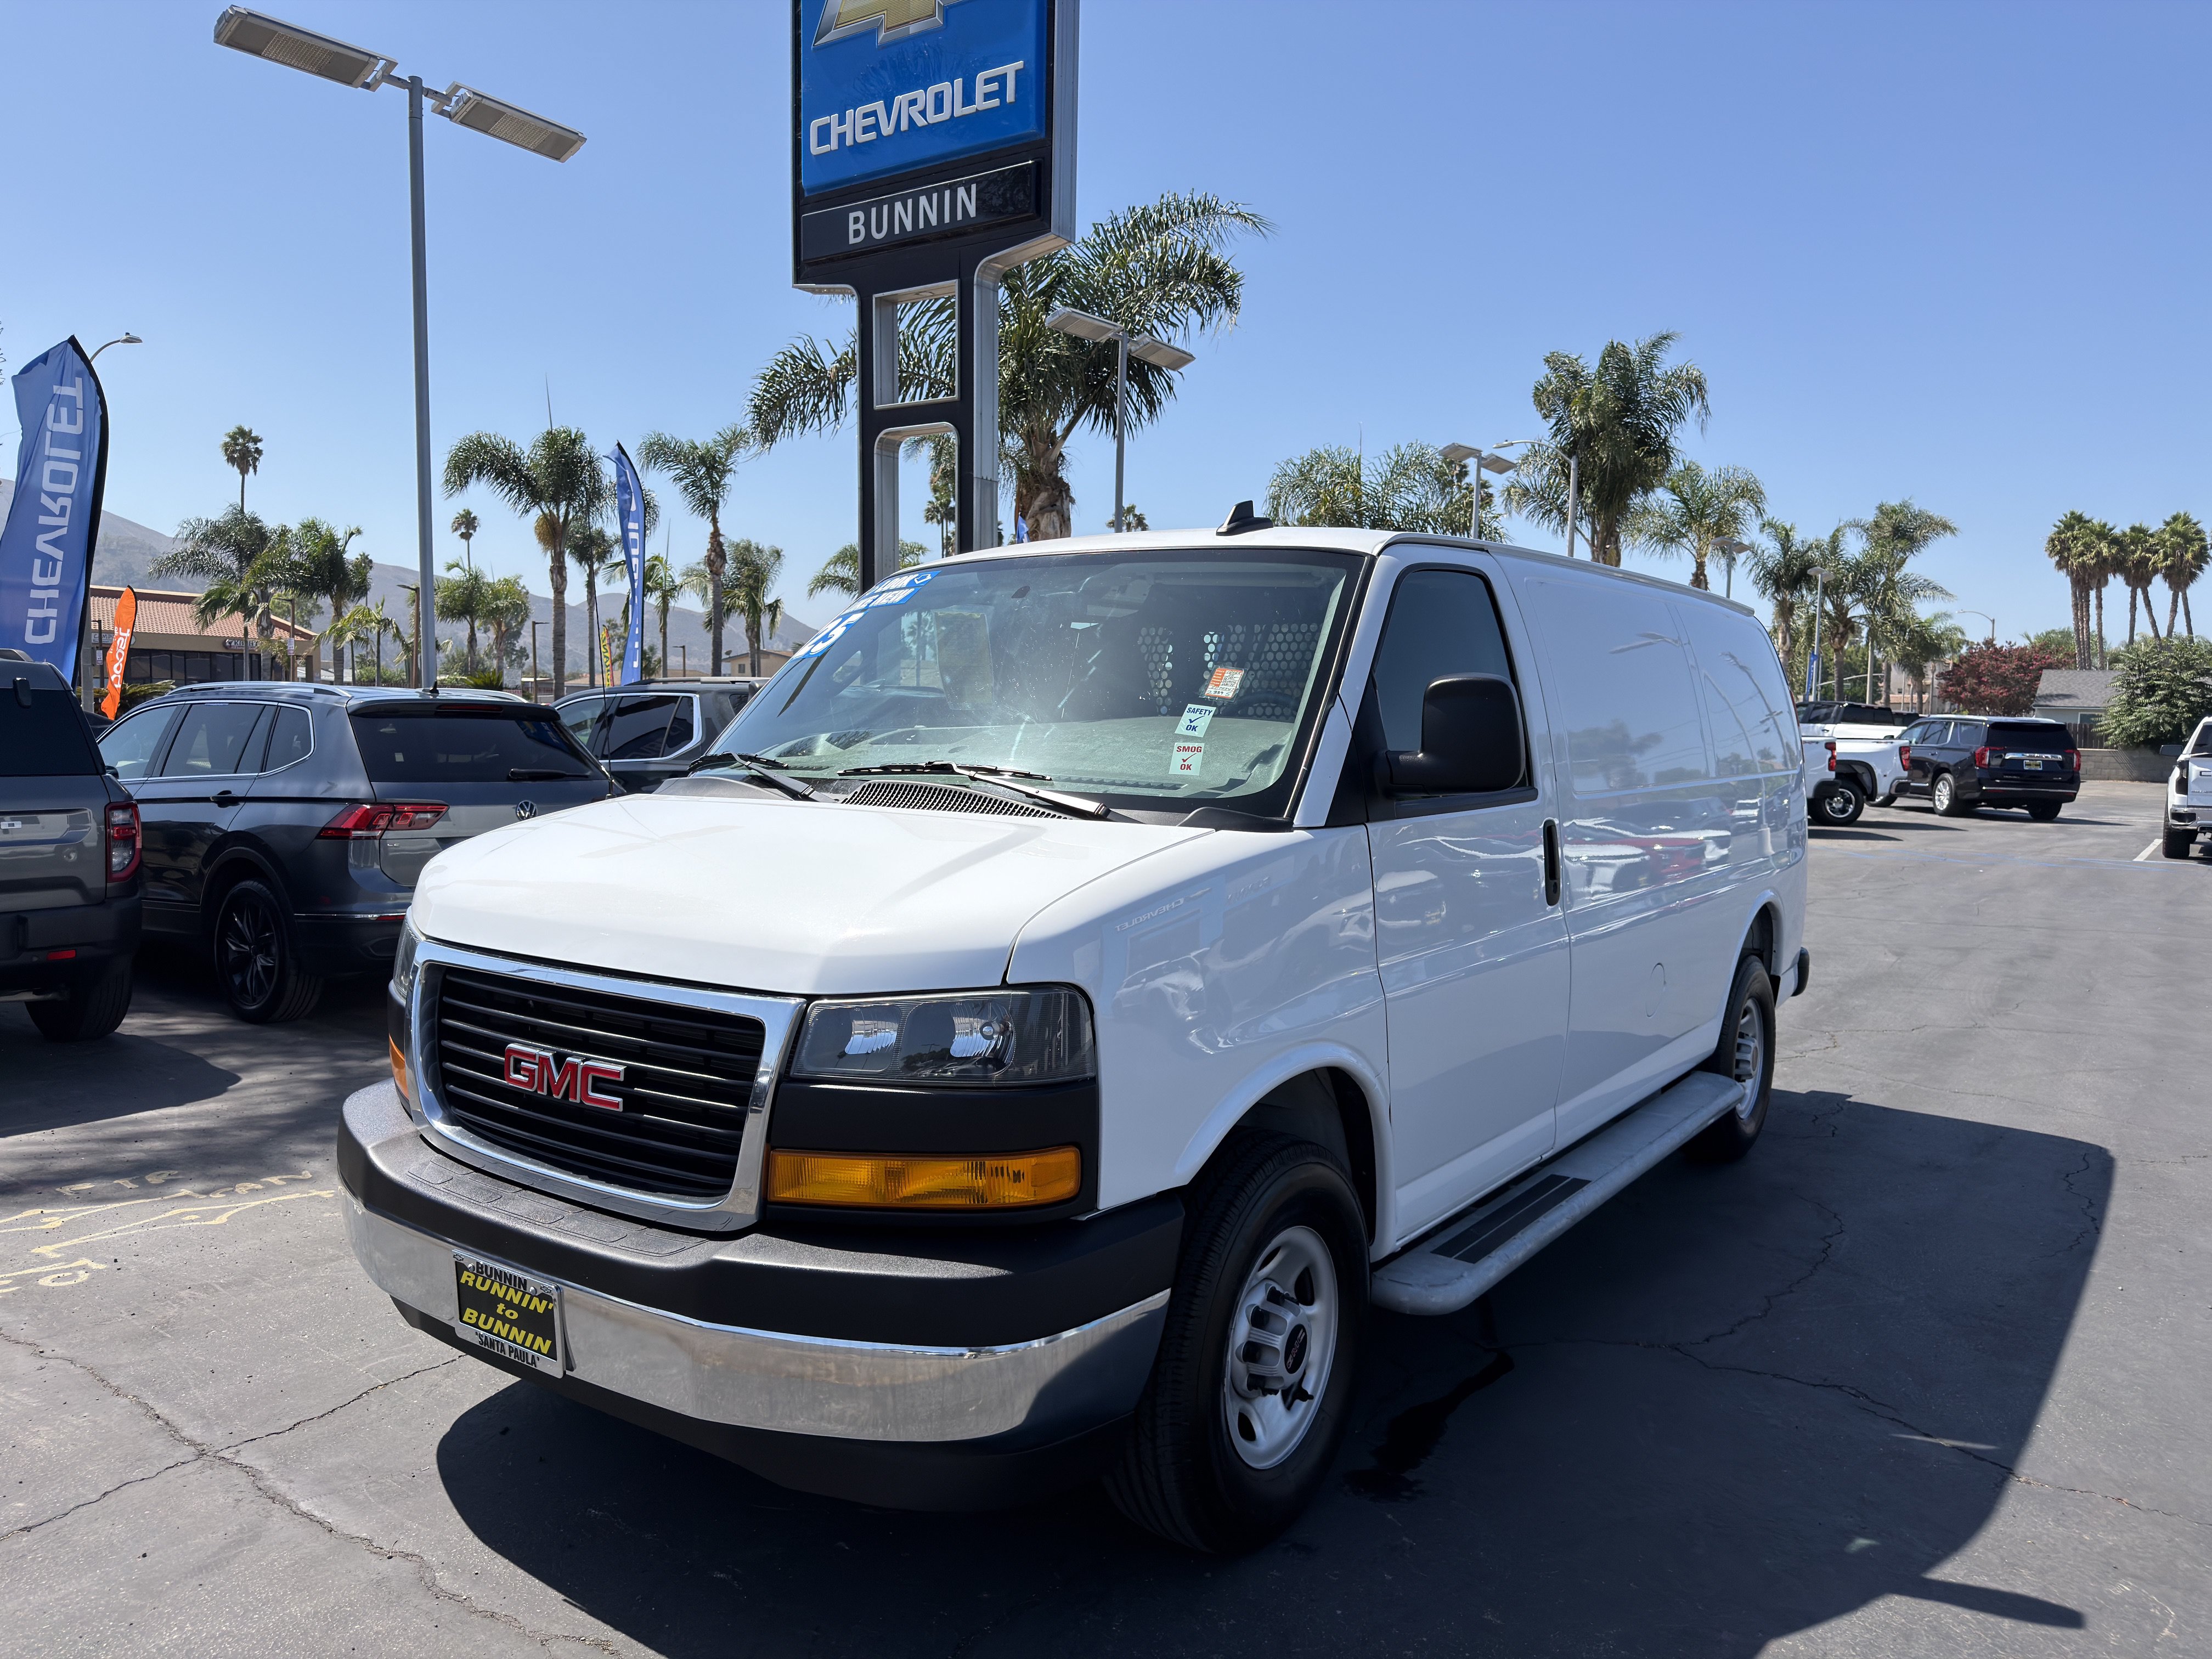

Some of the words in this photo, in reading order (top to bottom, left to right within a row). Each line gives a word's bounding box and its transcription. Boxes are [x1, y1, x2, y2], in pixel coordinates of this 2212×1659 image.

[810, 60, 1024, 156] CHEVROLET
[848, 183, 977, 245] BUNNIN
[1186, 707, 1213, 716] SAFETY
[504, 1042, 627, 1112] GMC
[476, 1261, 527, 1291] BUNNIN
[462, 1307, 552, 1355] BUNNIN
[496, 1302, 518, 1319] to
[478, 1333, 506, 1356] SANTA
[508, 1344, 537, 1368] PAULA
